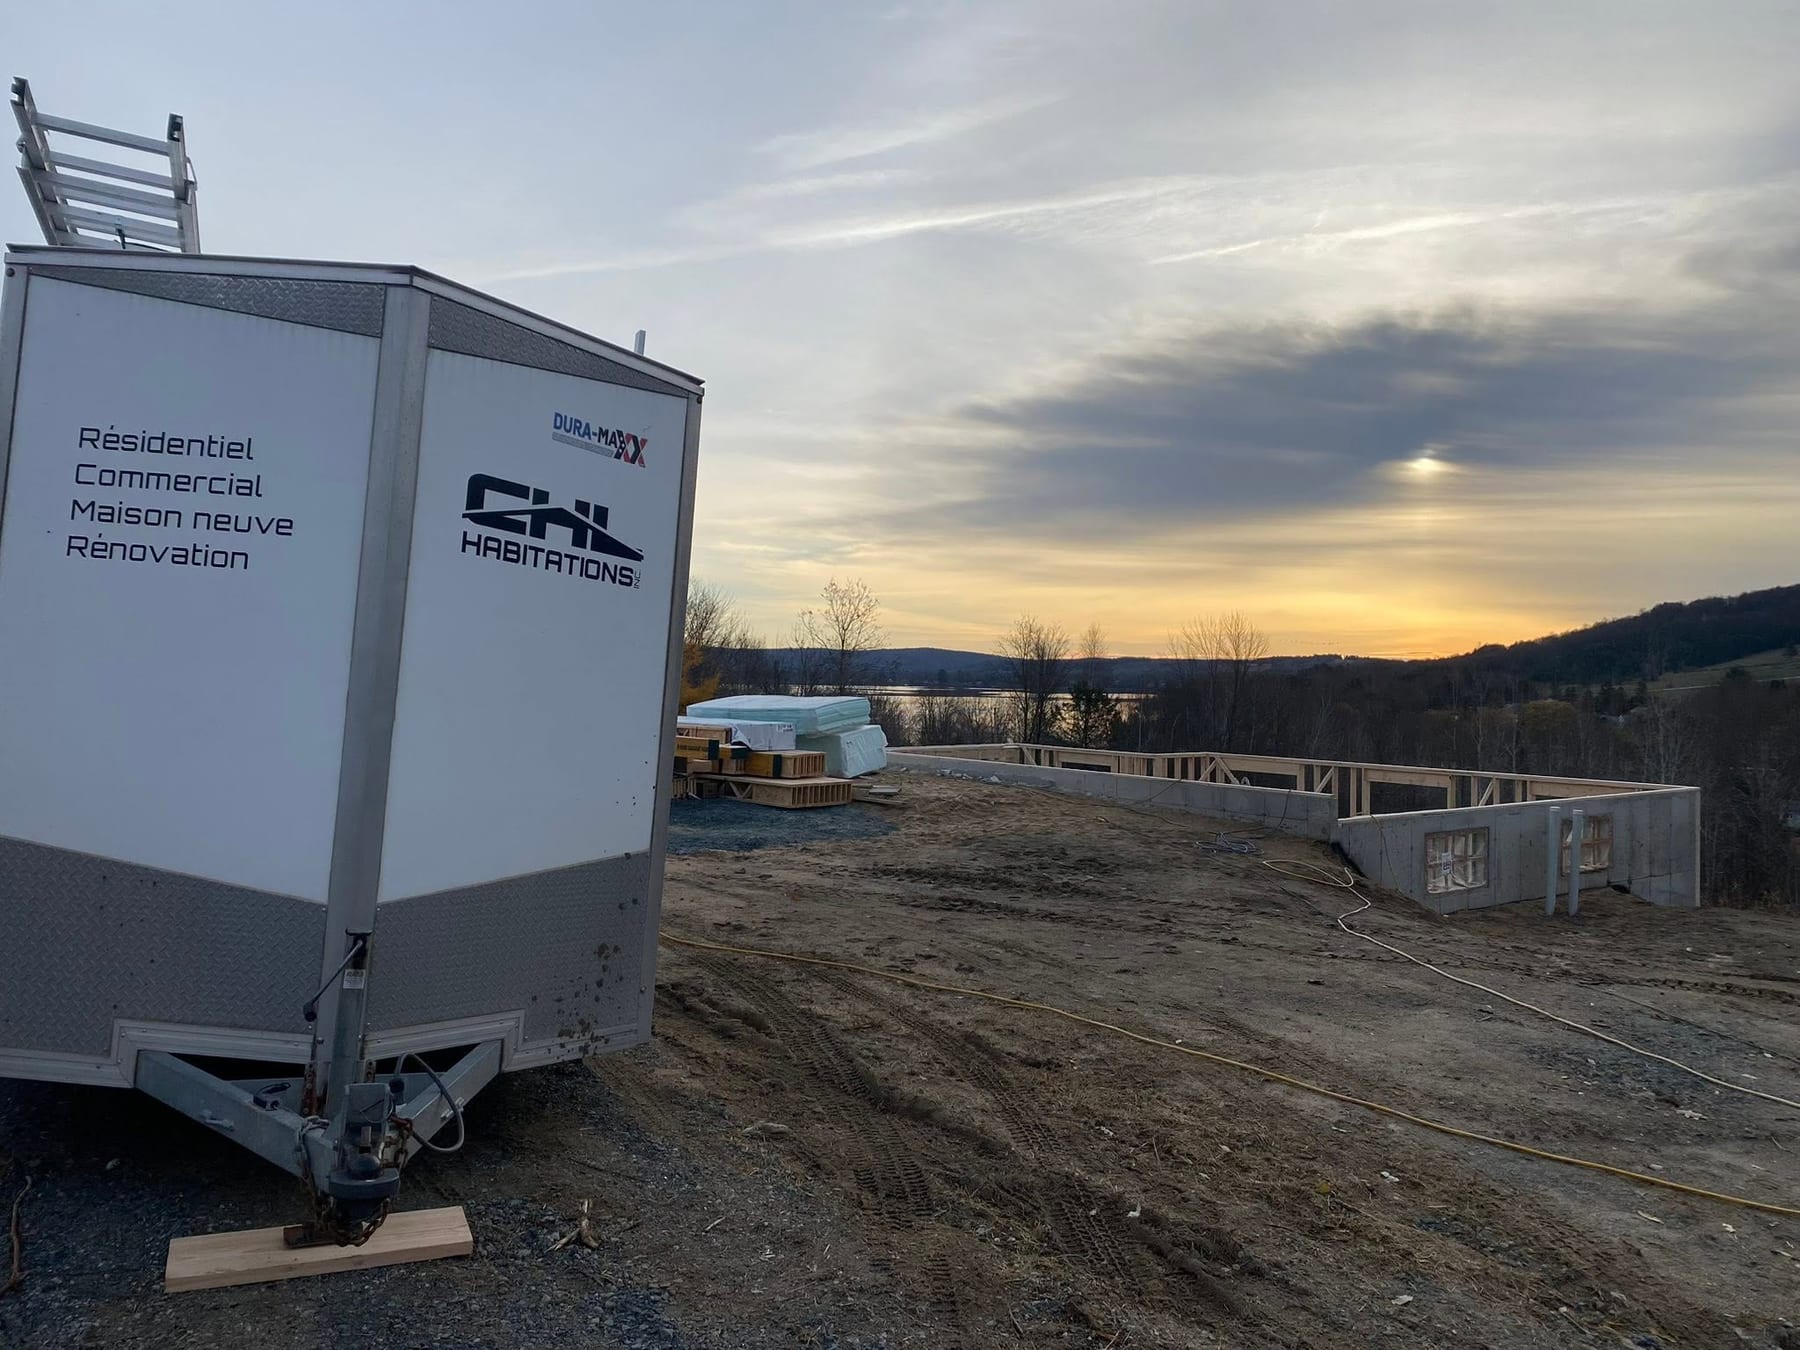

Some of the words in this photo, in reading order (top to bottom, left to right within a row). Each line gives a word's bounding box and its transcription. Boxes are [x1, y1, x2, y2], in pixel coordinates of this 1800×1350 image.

[78, 425, 254, 460] Résidentiel
[75, 463, 263, 497] Commercial
[70, 499, 182, 528] Maison
[192, 511, 294, 536] neuve
[66, 533, 249, 569] Rénovation
[461, 530, 634, 588] HABITATIONS
